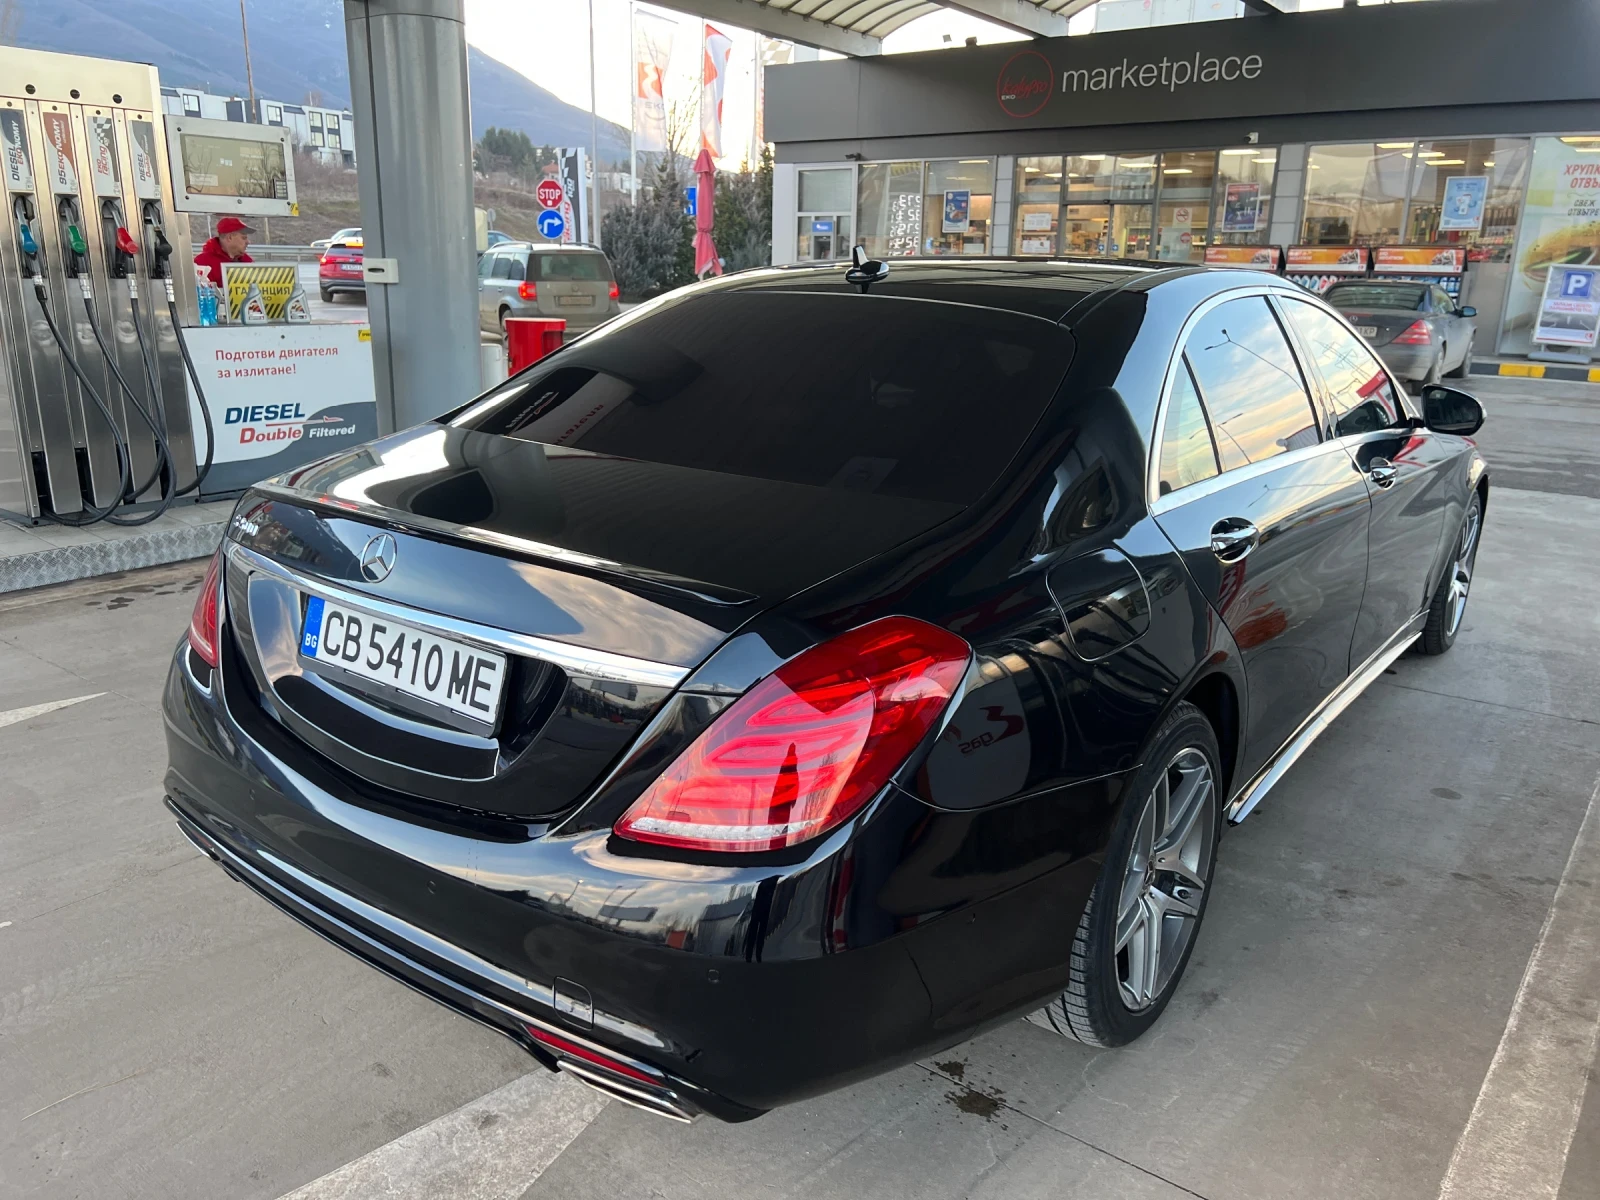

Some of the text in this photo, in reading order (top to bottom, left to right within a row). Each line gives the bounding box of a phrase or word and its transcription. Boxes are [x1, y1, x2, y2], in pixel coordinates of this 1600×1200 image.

[1062, 52, 1263, 92] marketplace
[12, 120, 23, 165] EKONOMY
[8, 146, 20, 181] DIESEL
[137, 153, 146, 181] DIESEL
[539, 188, 561, 200] STOP
[235, 286, 291, 296] ГАНЦИЯ
[215, 347, 338, 362] Подготви двигателя
[217, 363, 296, 378] за излитане!
[225, 403, 305, 424] DIESEL
[239, 424, 356, 444] Double Filtered
[304, 632, 318, 649] BG
[323, 610, 497, 713] CB 5410 ME
